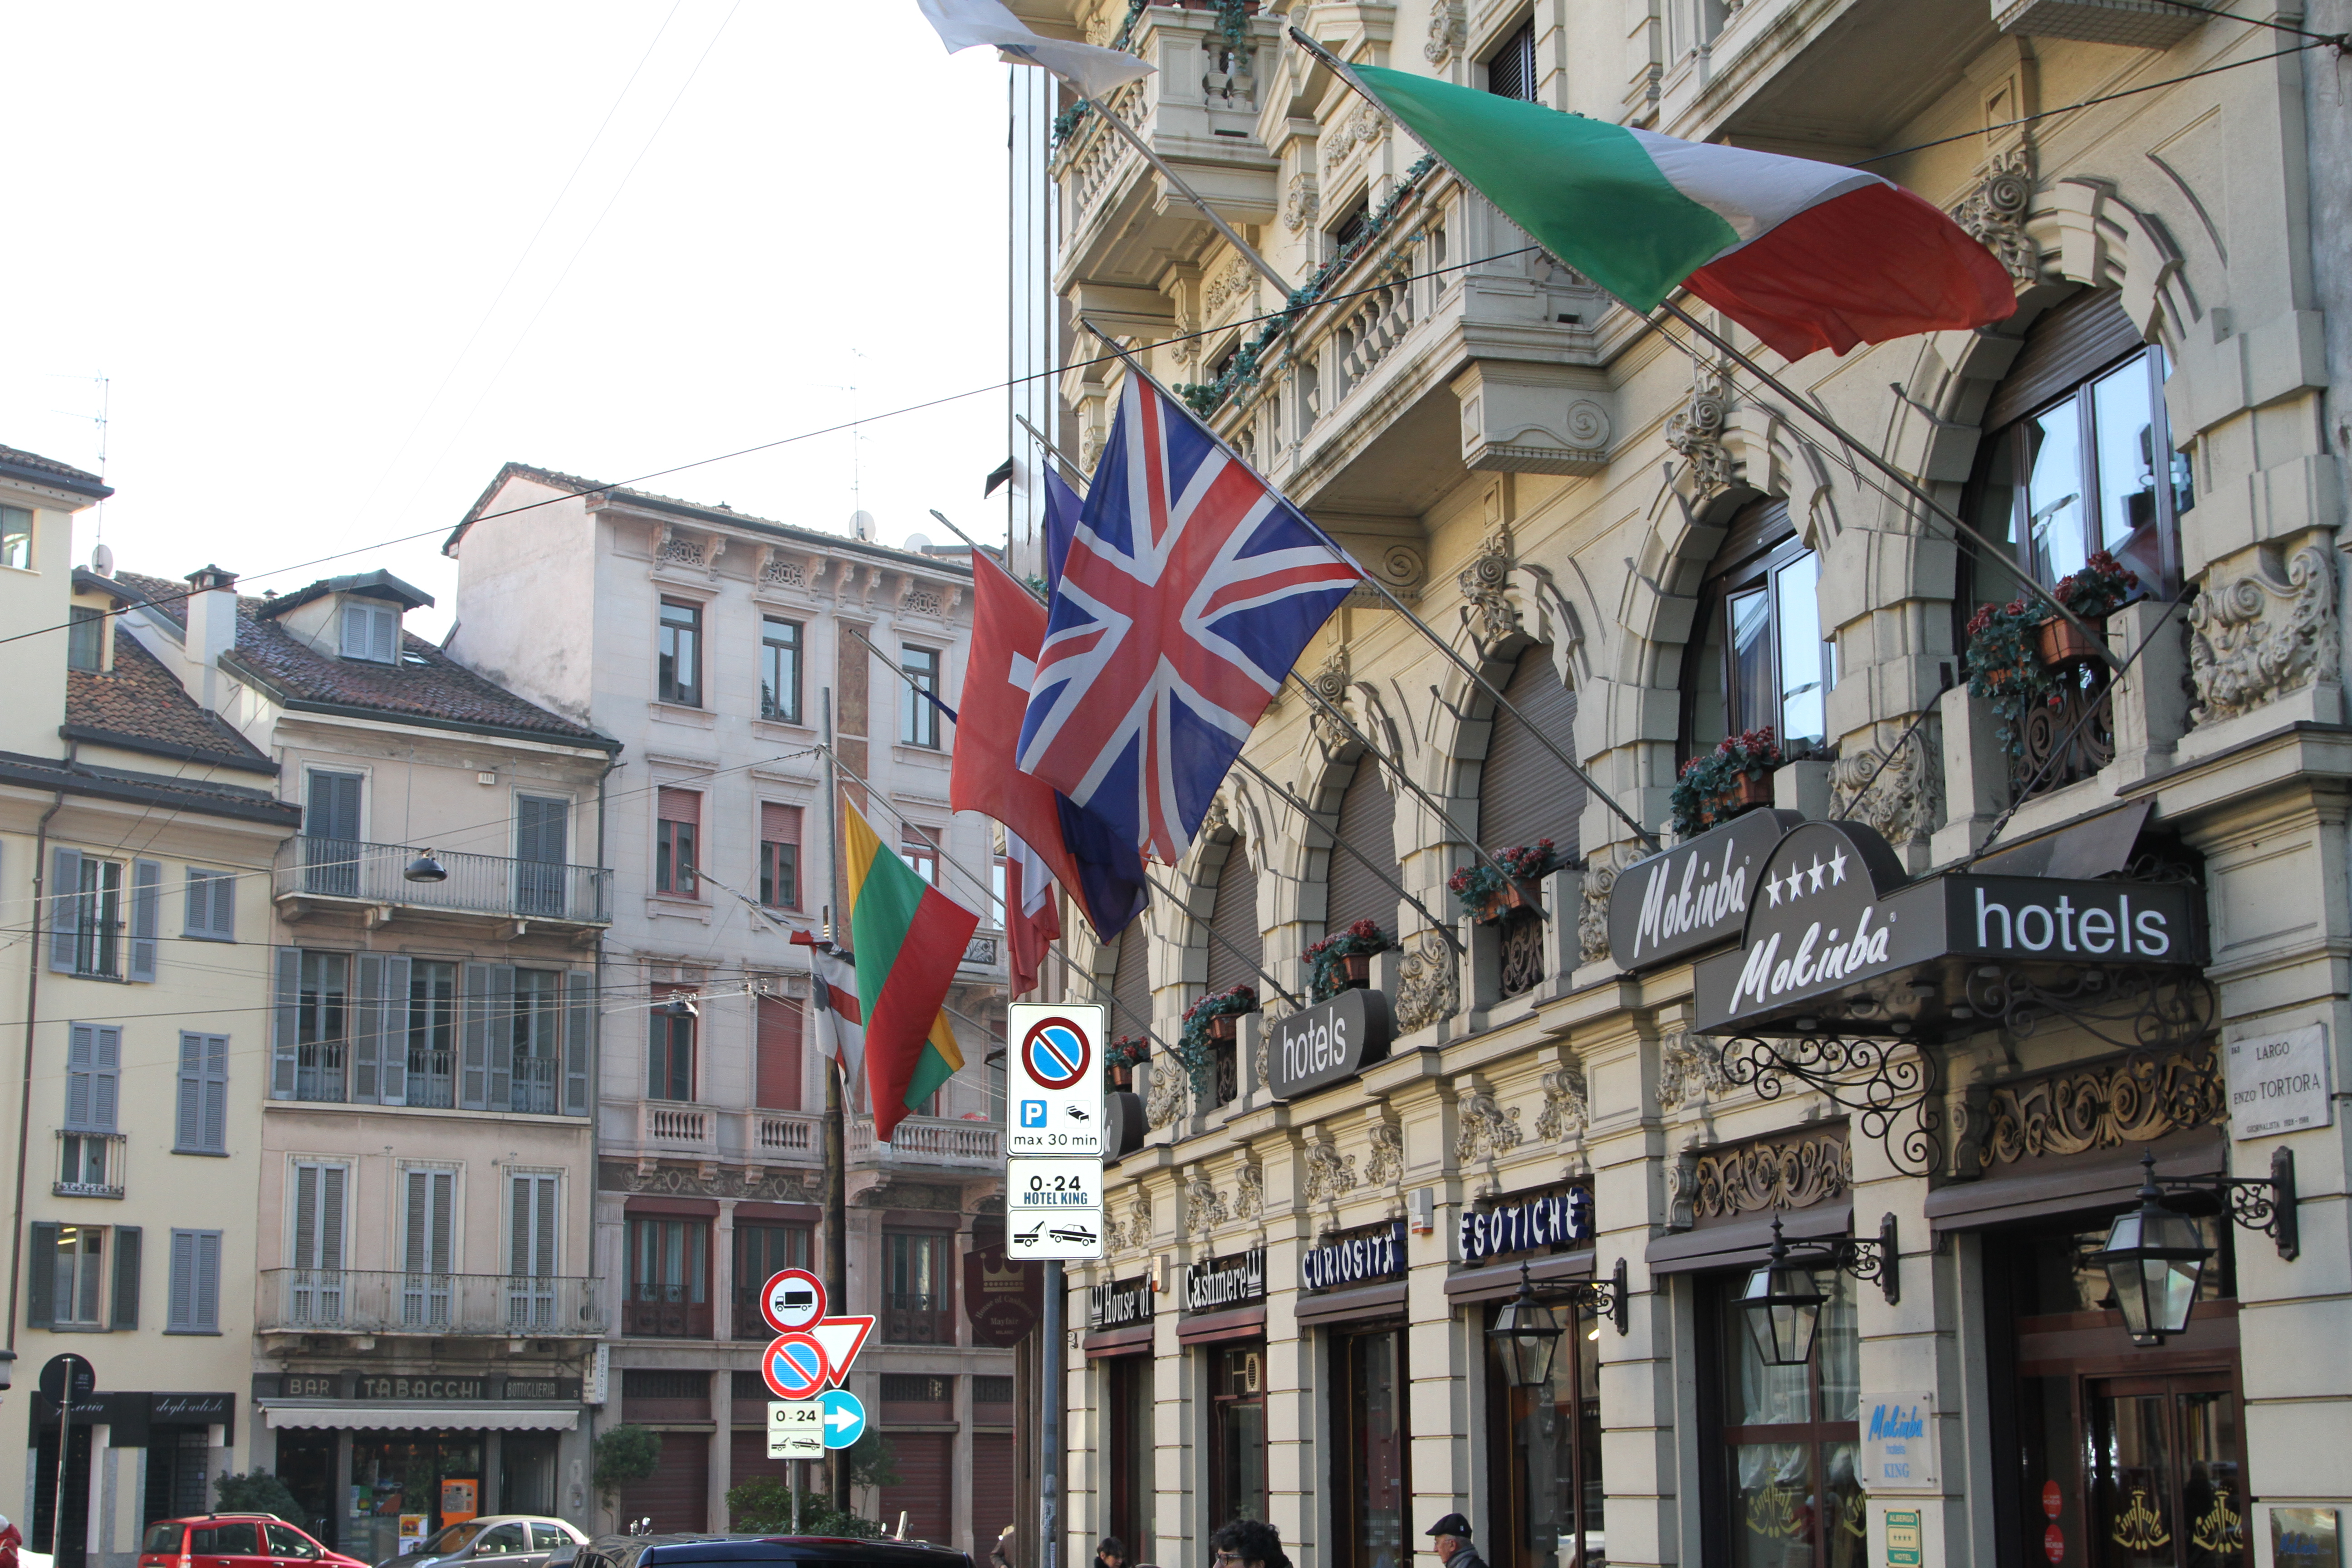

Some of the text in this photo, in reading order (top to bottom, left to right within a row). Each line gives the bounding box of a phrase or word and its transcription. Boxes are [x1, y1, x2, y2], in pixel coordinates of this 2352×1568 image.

[1635, 838, 1745, 958] Mokinba
[1975, 887, 2170, 956] hotels
[1729, 906, 1890, 1014] Mokinba
[1283, 1007, 1346, 1083] hotels
[2256, 1041, 2290, 1060] LARGO
[2234, 1073, 2321, 1105] ENZO TORTORA
[1014, 1133, 1097, 1146] max 30 min
[1024, 1192, 1088, 1205] HOTEL KING
[1458, 1187, 1579, 1259] ESOTICHE
[1185, 1261, 1247, 1309] Cashmere
[1104, 1273, 1151, 1324] House of
[990, 1317, 1019, 1327] Mayfair
[289, 1379, 330, 1395] BAR
[364, 1379, 481, 1399] TABACCHI
[507, 1380, 556, 1398] BOTTIGLIERIA
[573, 1389, 578, 1397] 3
[1884, 1462, 1910, 1478] KING
